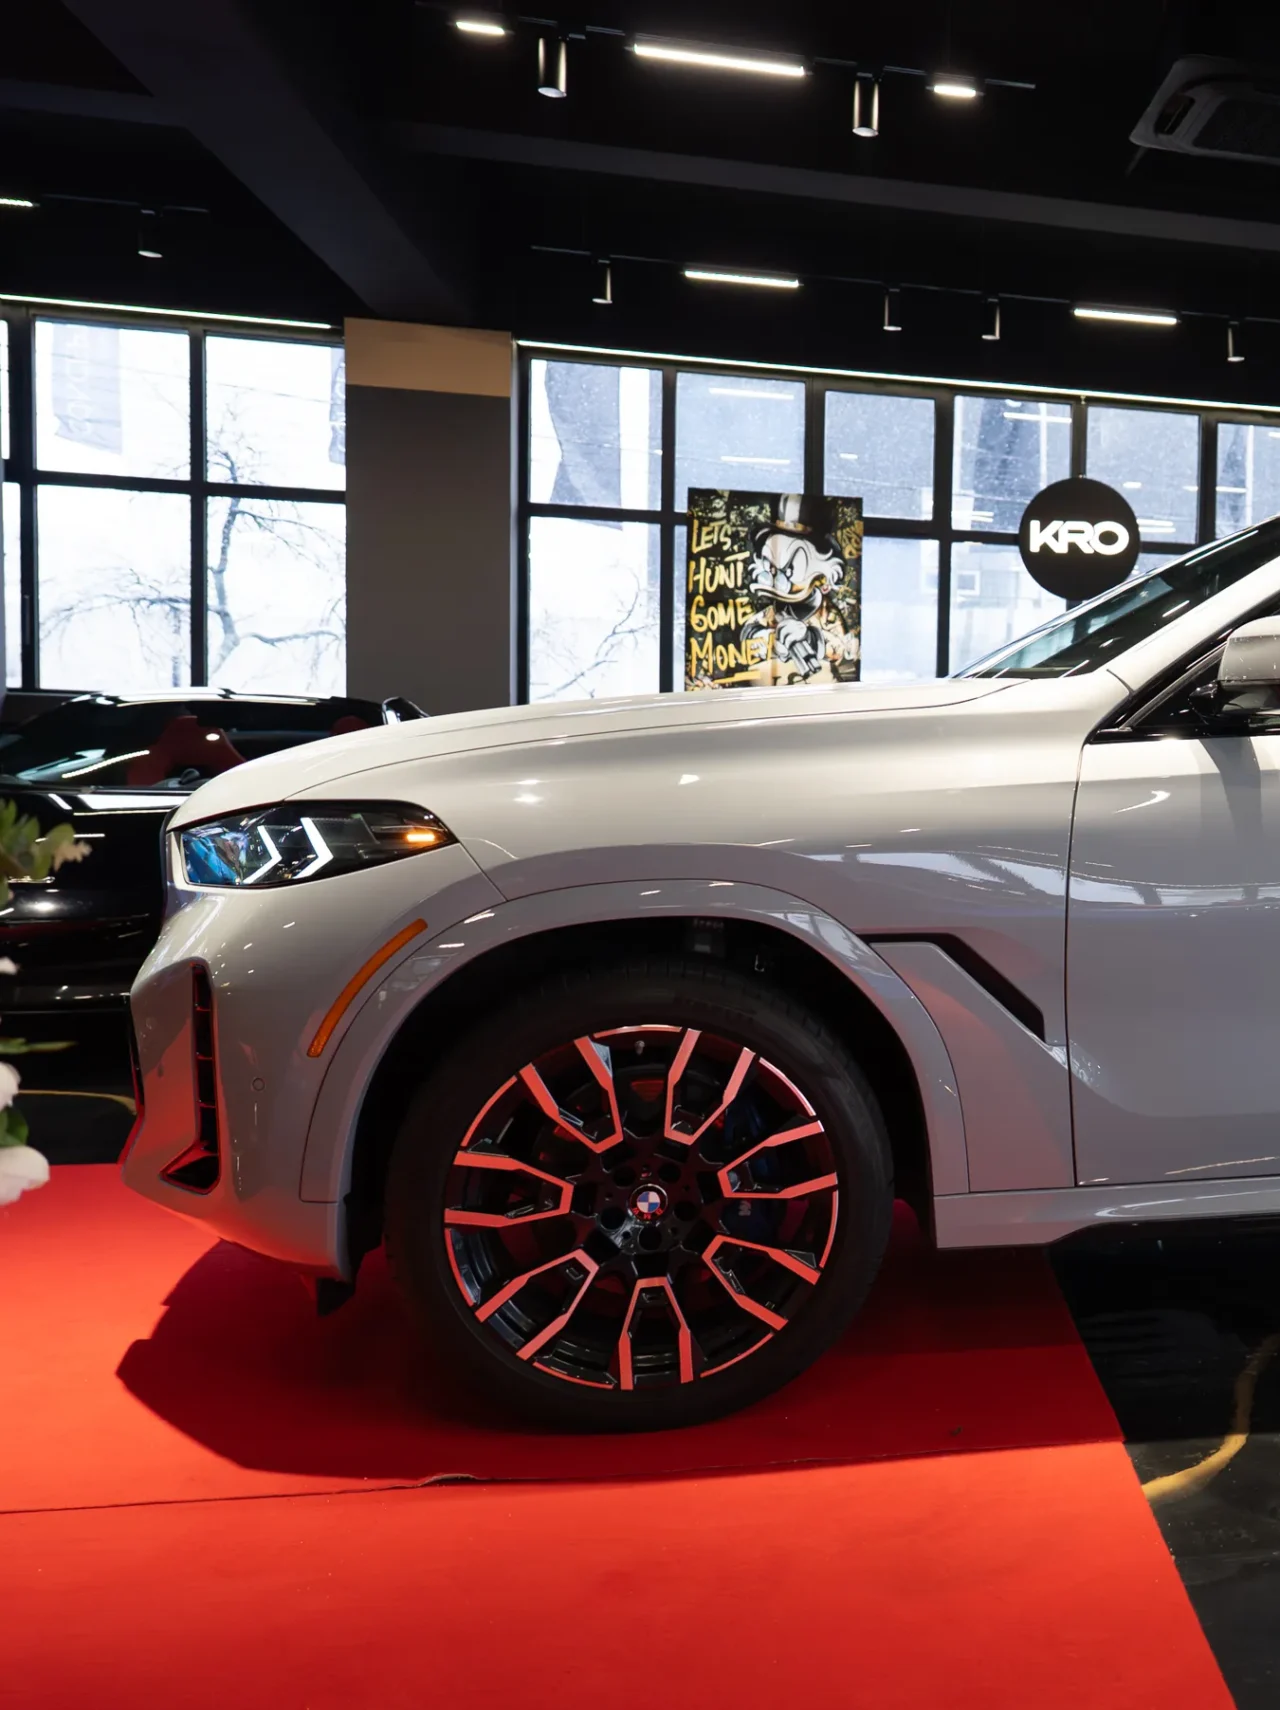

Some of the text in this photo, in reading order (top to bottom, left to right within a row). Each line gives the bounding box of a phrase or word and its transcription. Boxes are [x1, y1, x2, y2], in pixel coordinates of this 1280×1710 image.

[1029, 519, 1130, 556] KRO
[688, 551, 750, 595] HUNT
[689, 631, 776, 678] MONEY
